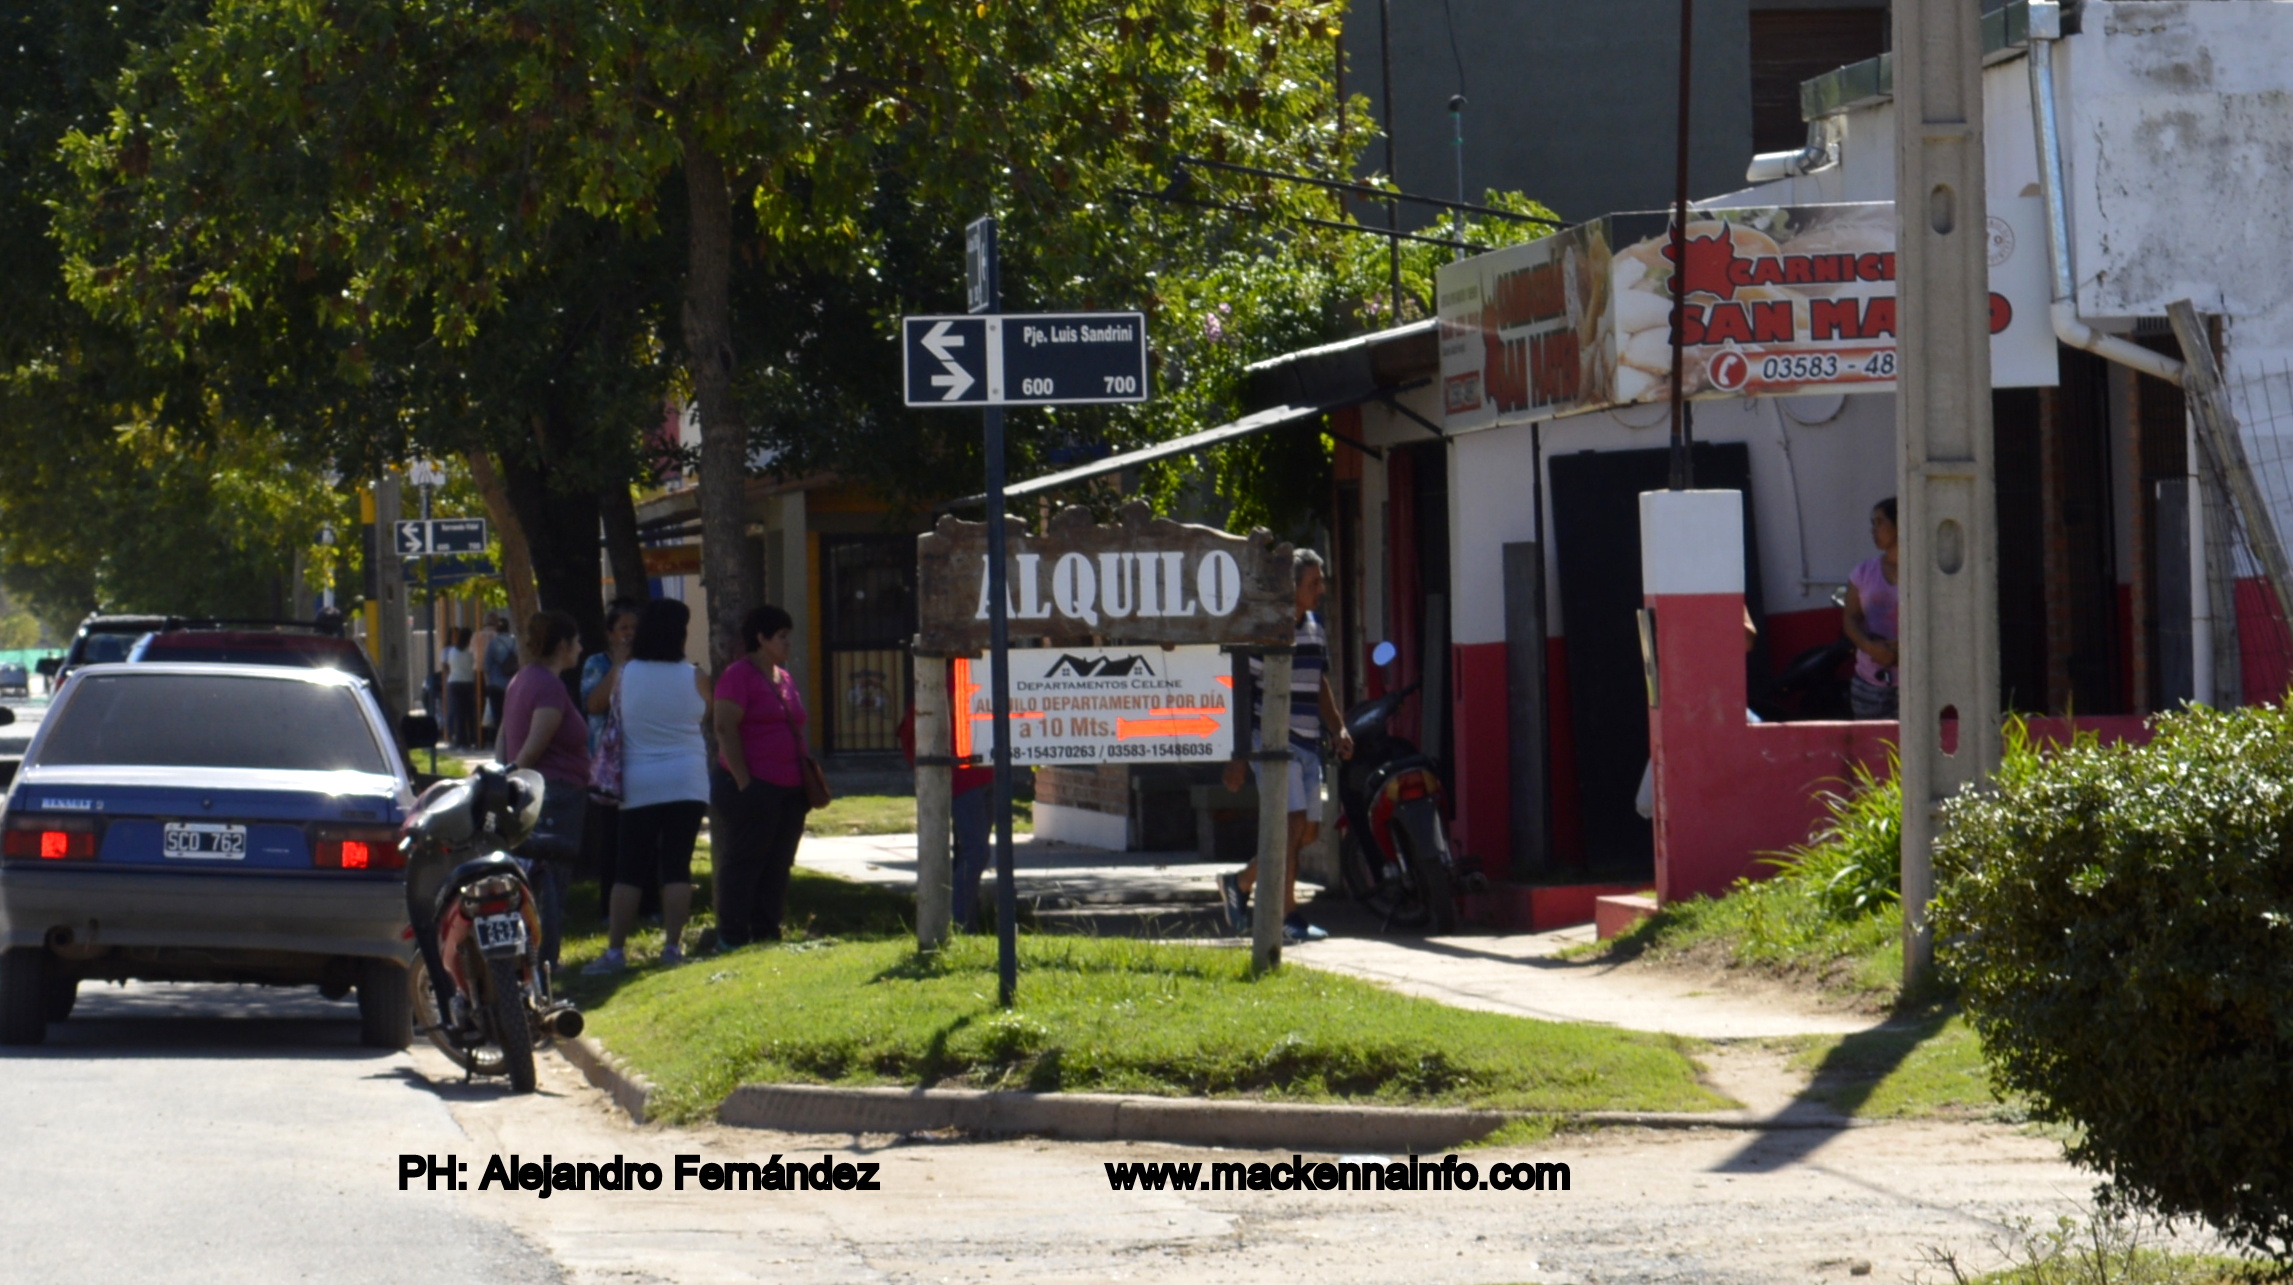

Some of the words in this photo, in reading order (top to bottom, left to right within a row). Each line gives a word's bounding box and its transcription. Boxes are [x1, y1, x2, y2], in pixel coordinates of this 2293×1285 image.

[1668, 300, 1795, 346] SAN
[1023, 326, 1048, 347] Pje.
[1051, 326, 1077, 343] Luis
[1081, 324, 1133, 343] Sandrini
[1762, 354, 1838, 380] 03583
[1864, 352, 1895, 375] 48
[1022, 378, 1054, 396] 600
[1104, 376, 1136, 394] 700
[1042, 694, 1160, 711] DEPARTAMENTO
[1166, 693, 1195, 709] POR
[1201, 689, 1225, 708] DÍA
[1019, 722, 1031, 738] a
[1038, 717, 1064, 738] 10
[1071, 716, 1116, 737] Mts.
[1107, 743, 1213, 758] 03583-15486036
[212, 833, 243, 853] 762
